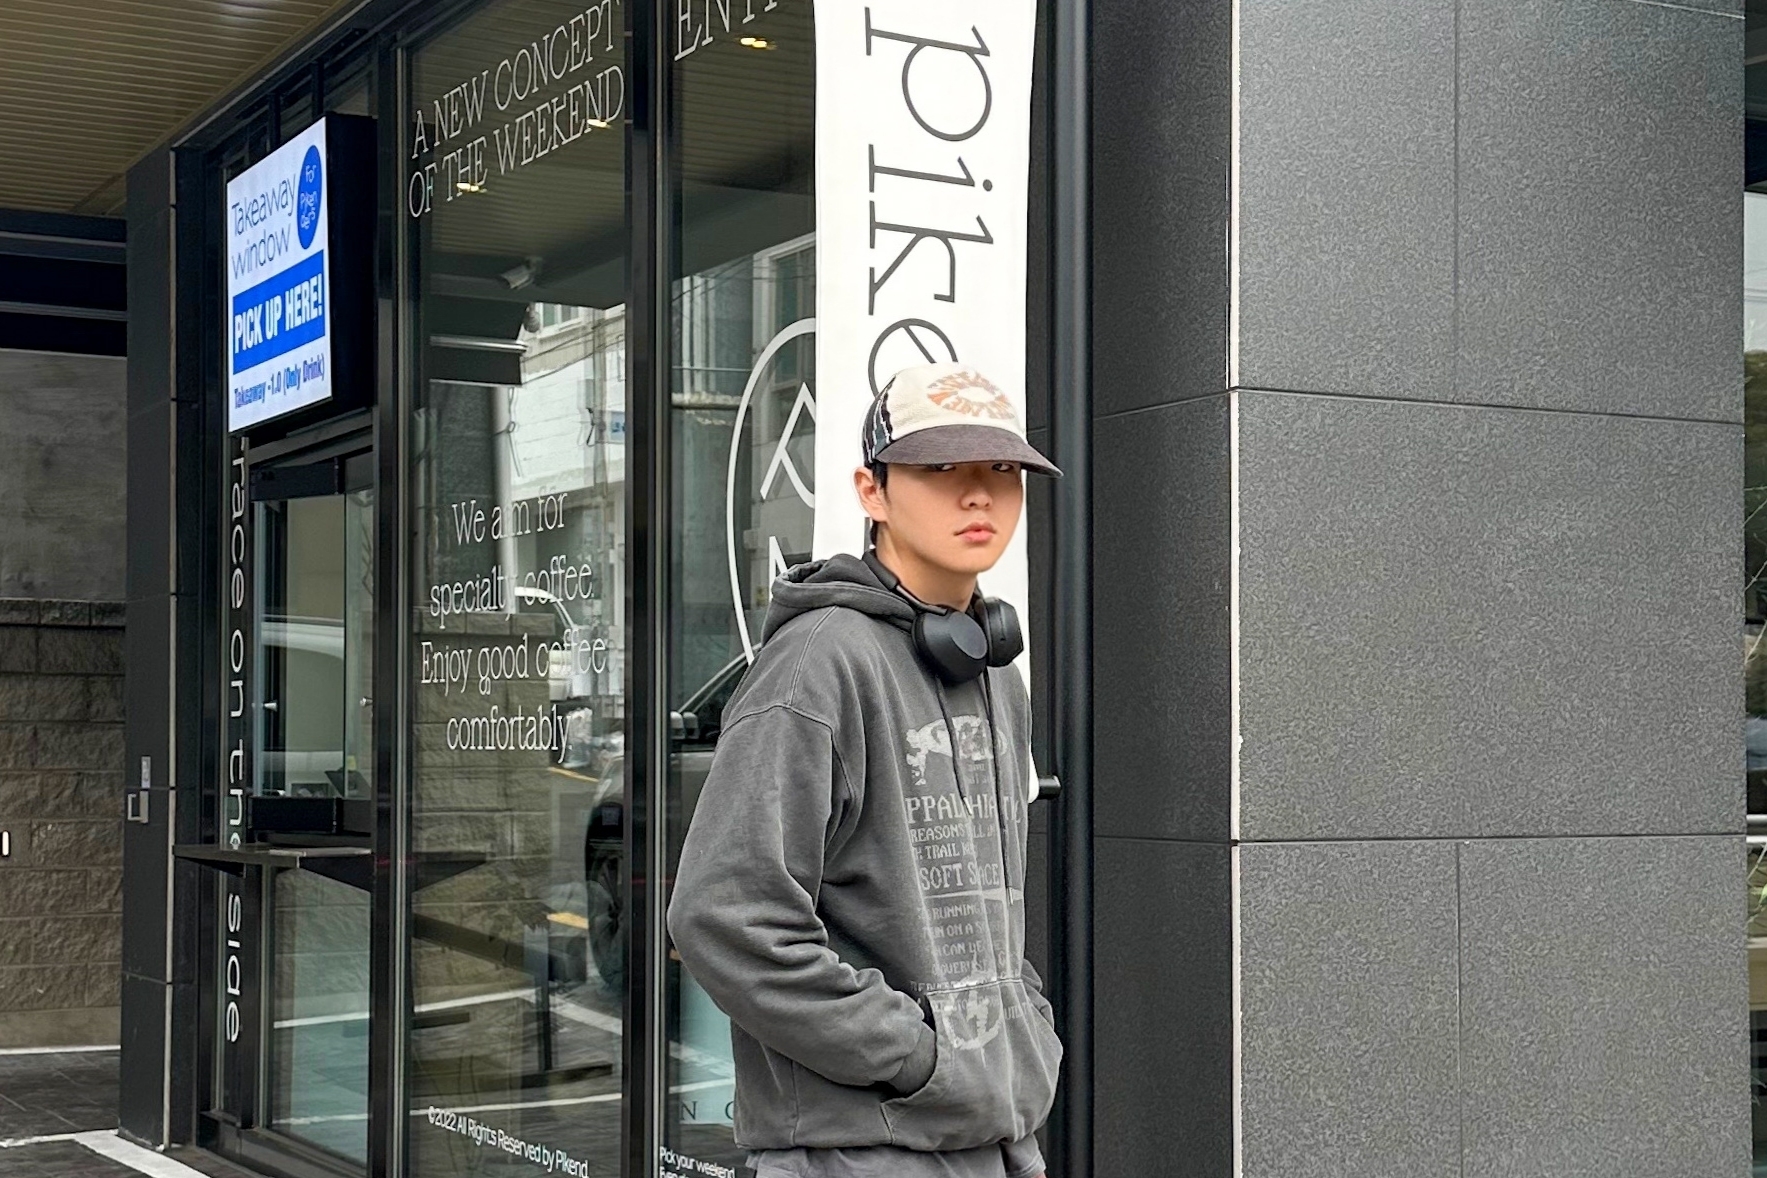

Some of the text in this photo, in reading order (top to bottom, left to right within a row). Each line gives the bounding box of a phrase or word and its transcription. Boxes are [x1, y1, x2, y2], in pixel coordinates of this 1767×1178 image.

[411, 0, 620, 159] A NEW CONCEPT
[408, 65, 624, 218] OF THE WEEKEND
[231, 173, 296, 237] Takeaway
[231, 223, 292, 280] window
[234, 273, 322, 354] PICK UP HERE!
[451, 499, 486, 546] We
[536, 486, 568, 532] for
[430, 565, 518, 629] specialty
[420, 627, 607, 696] Enjoy good coffee
[447, 703, 573, 764] comfortably.
[919, 862, 964, 891] SOFT
[457, 1116, 467, 1135] All
[468, 1118, 497, 1146] Rights
[498, 1129, 541, 1162] Reserved
[542, 1144, 554, 1172] by
[676, 1154, 695, 1170] your
